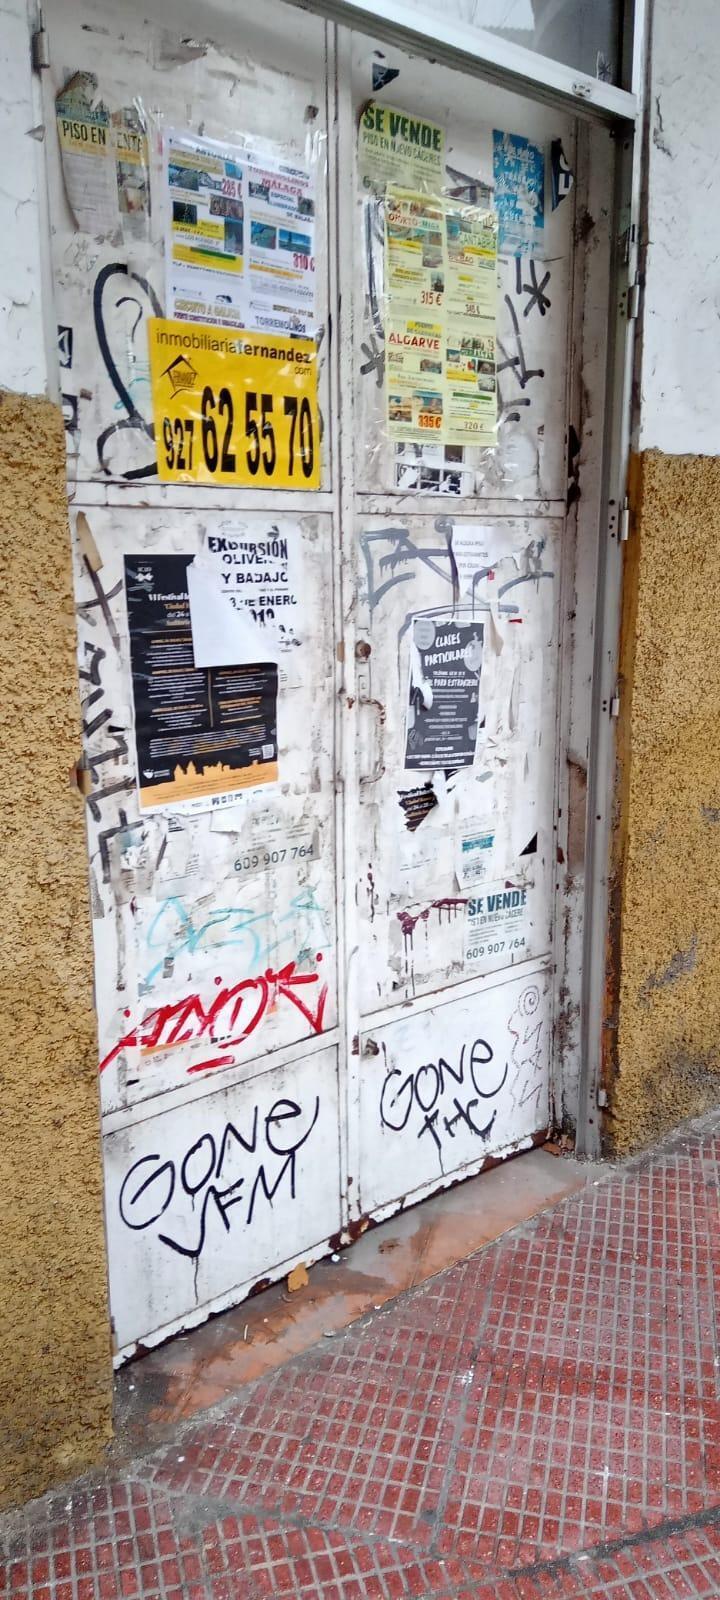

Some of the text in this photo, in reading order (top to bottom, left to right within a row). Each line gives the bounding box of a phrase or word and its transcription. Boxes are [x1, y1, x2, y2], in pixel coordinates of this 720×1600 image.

[63, 120, 88, 142] PISO
[92, 126, 107, 146] EN
[363, 106, 442, 152] SE VENDE
[420, 290, 435, 306] 315
[388, 332, 440, 350] ALGARVE
[163, 385, 314, 479] 927 62 55 70
[221, 572, 232, 584] Y
[234, 843, 314, 872] 609 907 764
[468, 889, 527, 917] SE VENDE
[466, 942, 485, 960] 609
[488, 940, 506, 955] 907
